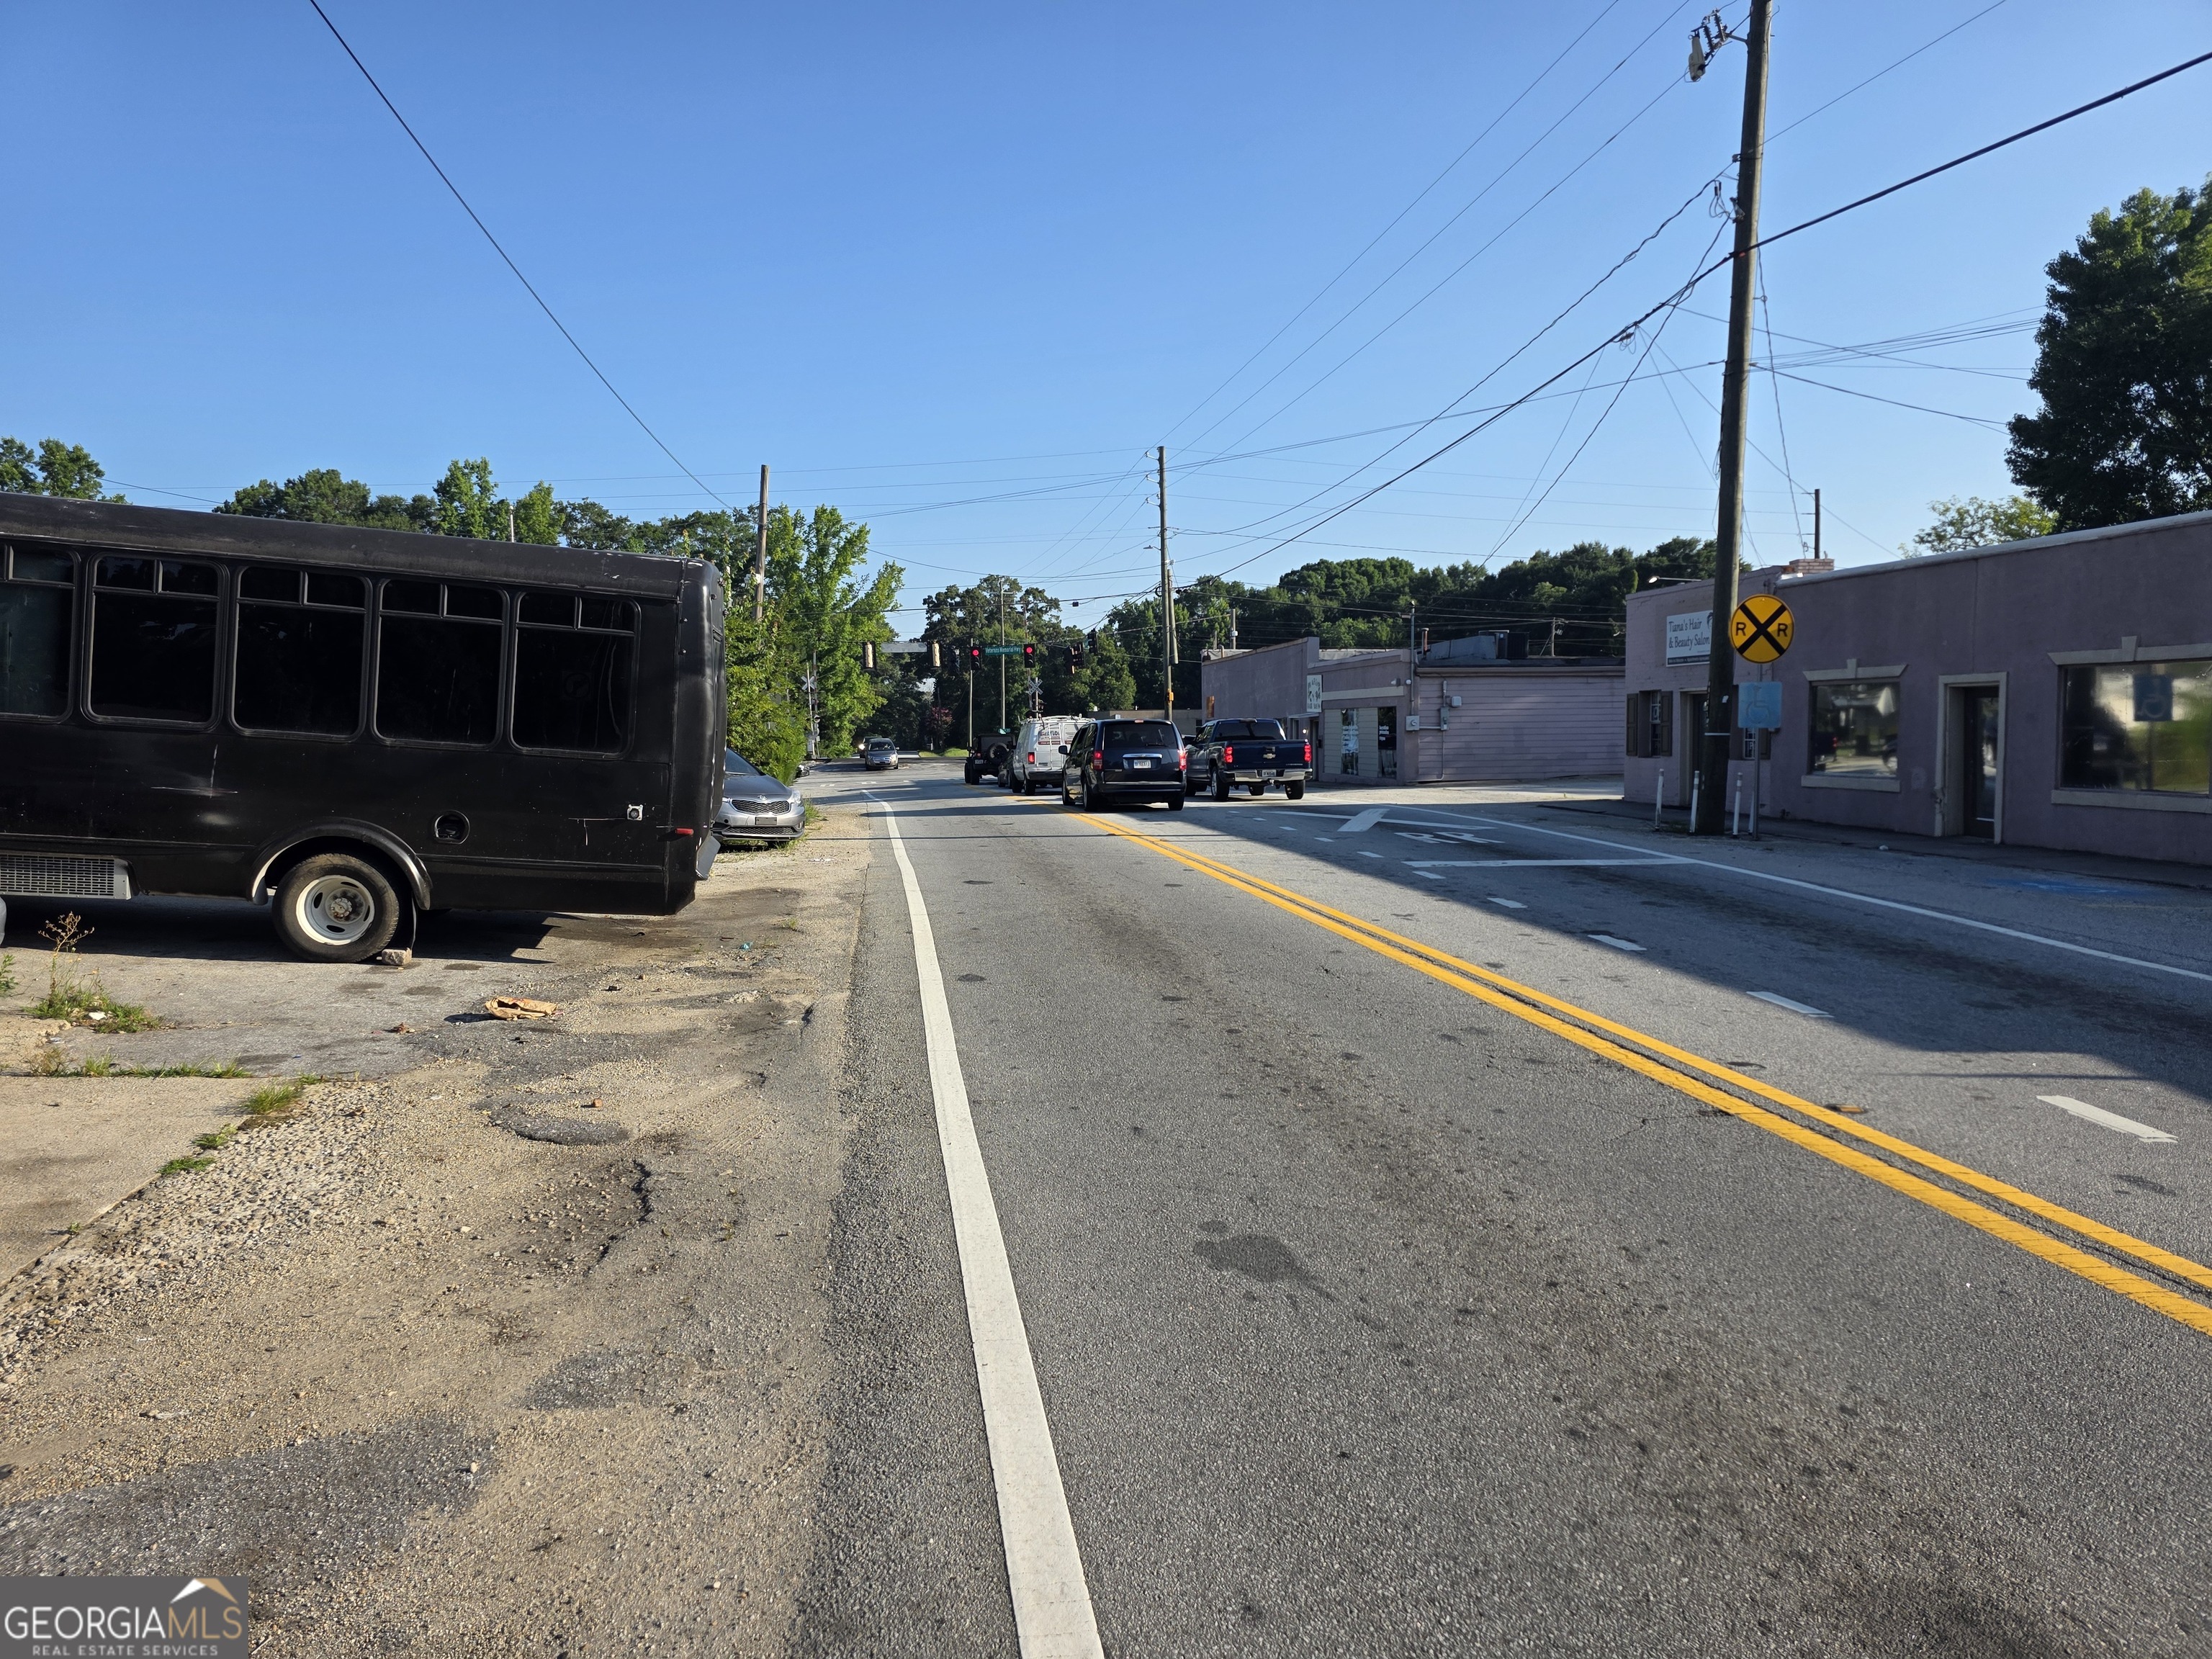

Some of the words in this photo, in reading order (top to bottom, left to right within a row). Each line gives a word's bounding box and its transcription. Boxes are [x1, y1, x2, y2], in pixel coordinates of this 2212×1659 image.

[1668, 619, 1688, 632] Tiana's
[1689, 619, 1702, 630] Hair
[1735, 622, 1746, 636] R
[1777, 623, 1788, 637] R
[1668, 637, 1674, 648] &
[1675, 635, 1693, 651] Beauty
[1694, 631, 1710, 646] Salon
